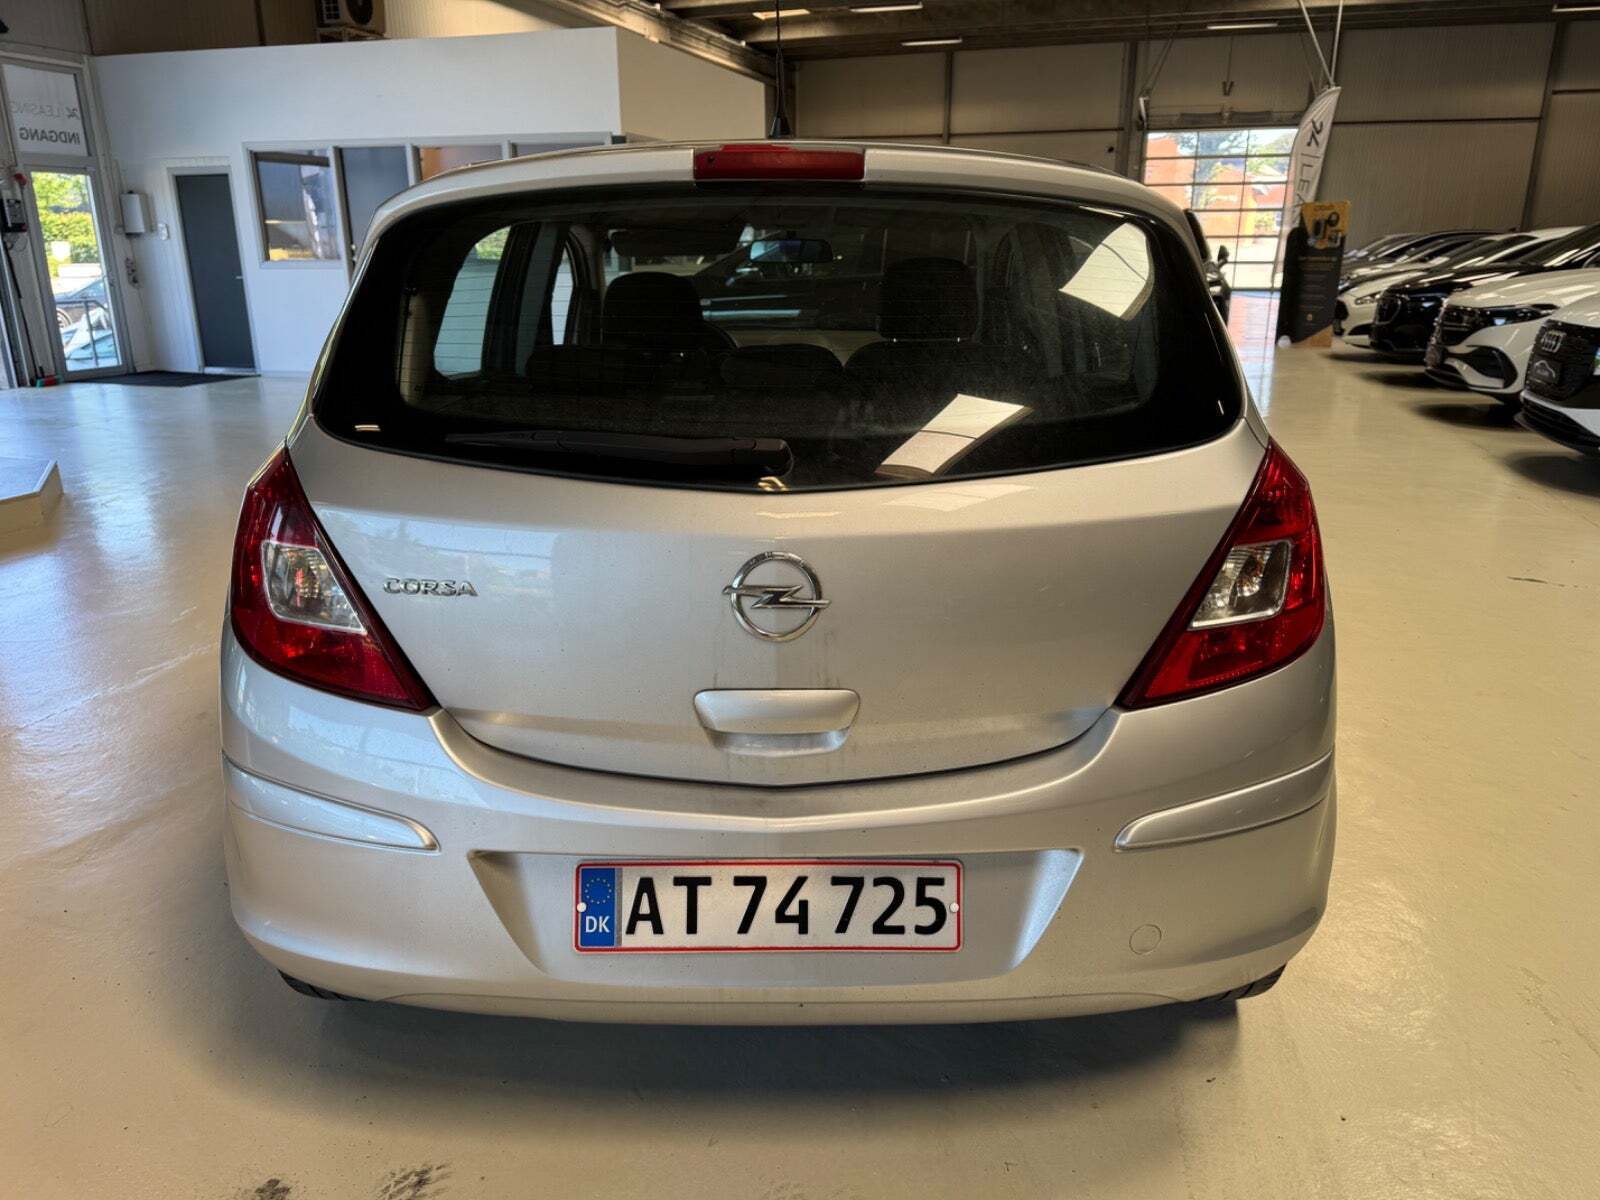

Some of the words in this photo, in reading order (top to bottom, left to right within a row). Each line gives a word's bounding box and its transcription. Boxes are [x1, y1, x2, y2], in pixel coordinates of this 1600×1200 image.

[383, 577, 478, 597] CORSA
[625, 876, 712, 935] AT
[732, 875, 809, 935] 74
[830, 875, 948, 935] 725
[584, 915, 610, 934] DK
